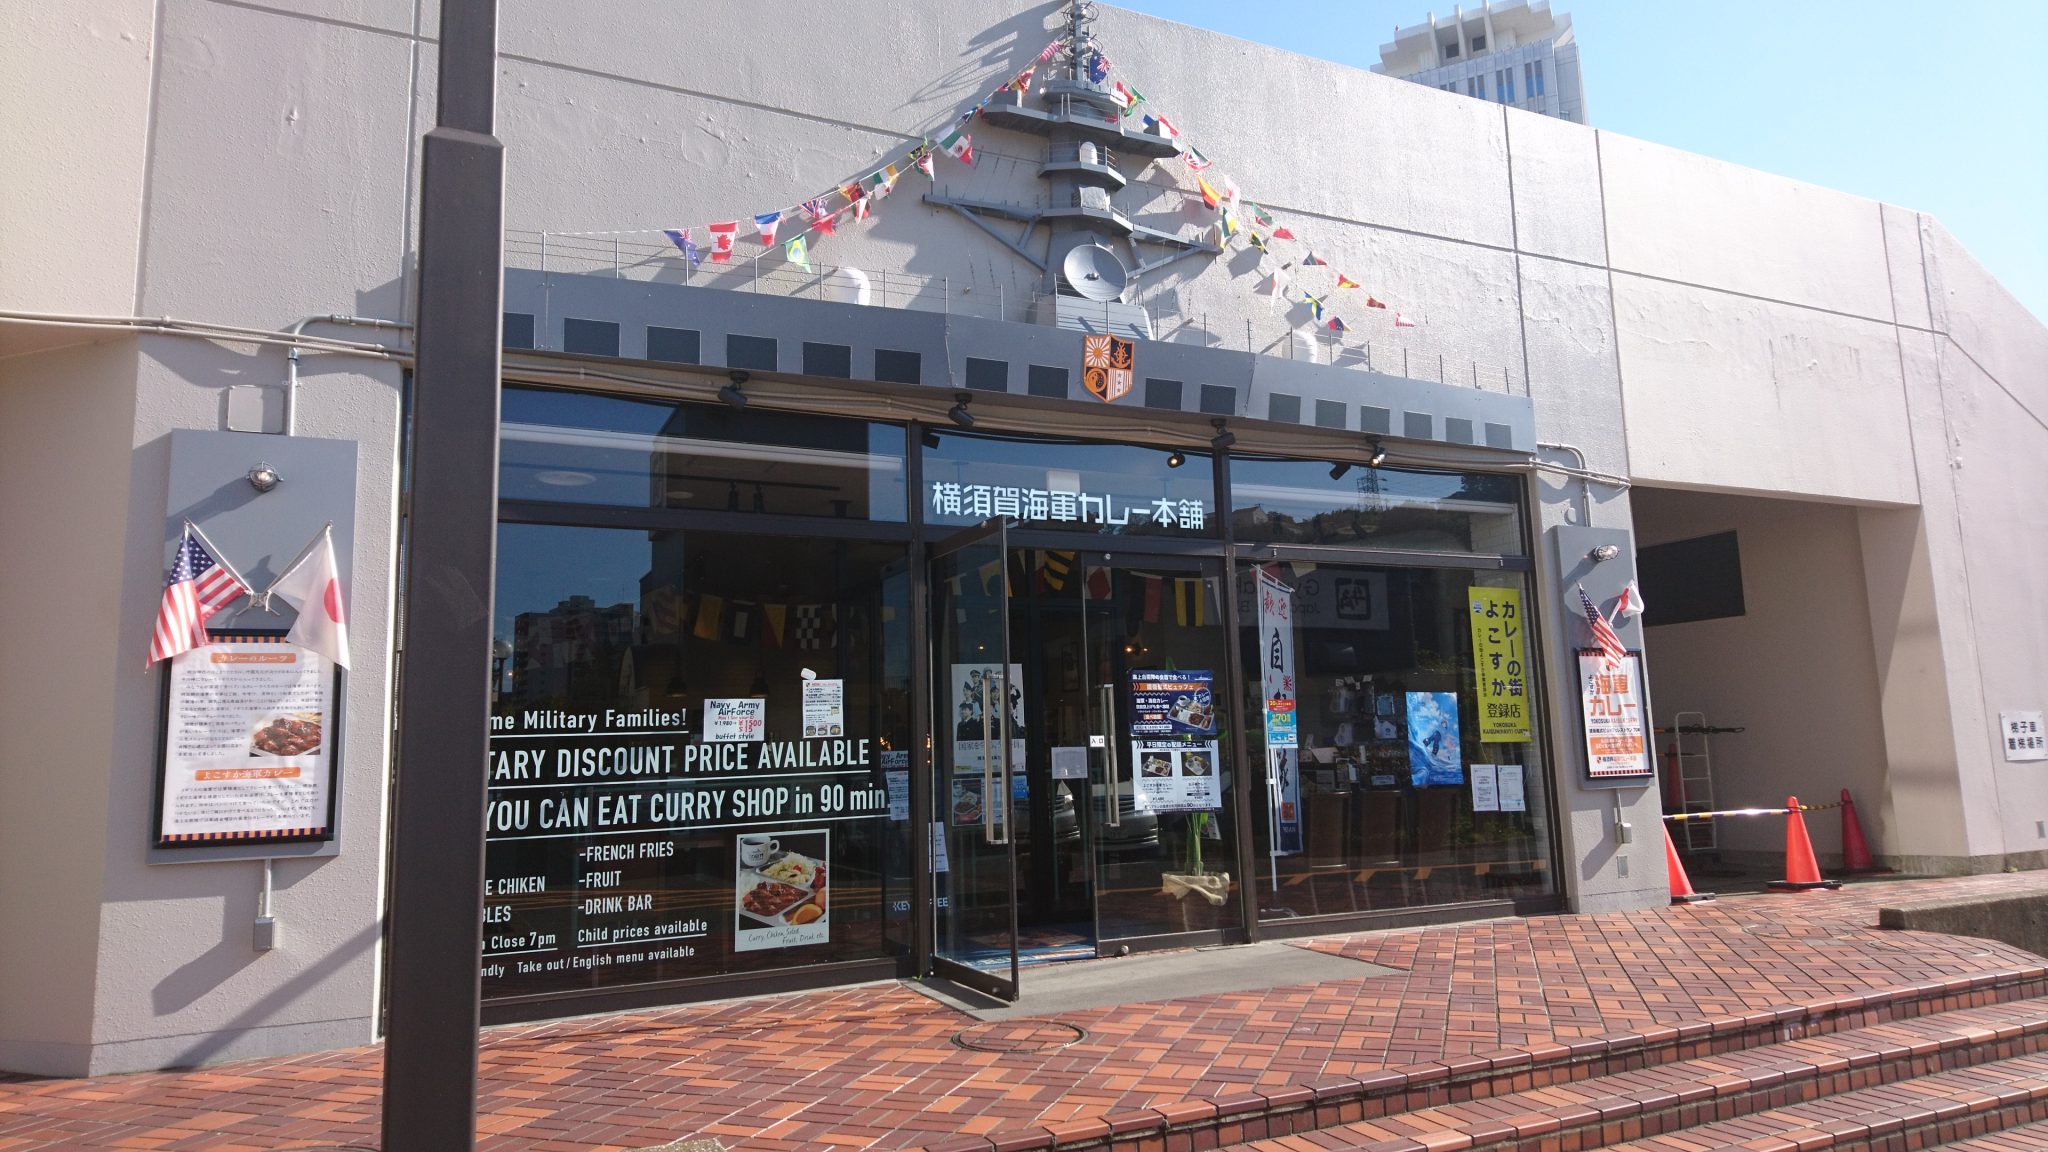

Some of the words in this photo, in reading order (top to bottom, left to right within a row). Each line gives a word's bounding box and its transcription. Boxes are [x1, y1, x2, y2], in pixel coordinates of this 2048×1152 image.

[932, 481, 1204, 530] 横須賀海軍カレー本舗
[1485, 600, 1506, 697] よこすか
[1502, 601, 1524, 697] カレーの街
[1595, 673, 1629, 695] 海軍
[710, 700, 731, 709] Navy
[738, 700, 760, 709] Army
[718, 707, 755, 716] AirForce
[1486, 702, 1521, 719] 登録店
[1590, 696, 1637, 717] カレー
[524, 709, 598, 733] Military
[605, 708, 687, 728] Families!
[557, 745, 675, 778] DISCOUNT
[684, 742, 749, 773] PRICE
[757, 738, 870, 770] AVAILABLE
[203, 769, 295, 780] よこすか海軍カレー
[539, 796, 589, 829] CAN
[598, 794, 642, 826] EAT
[650, 790, 726, 823] CURRY
[732, 787, 789, 818] SHOP
[795, 786, 813, 815] in
[820, 783, 845, 812] 90
[639, 841, 674, 858] FRIES
[498, 876, 546, 895] CHIKEN
[627, 894, 653, 912] BAR
[491, 933, 526, 950] Close
[529, 931, 556, 950] 7pm
[577, 928, 608, 943] Child
[612, 924, 650, 944] prices
[654, 918, 708, 935] available
[516, 960, 542, 974] Take
[616, 950, 644, 964] menu
[648, 945, 695, 961] available
